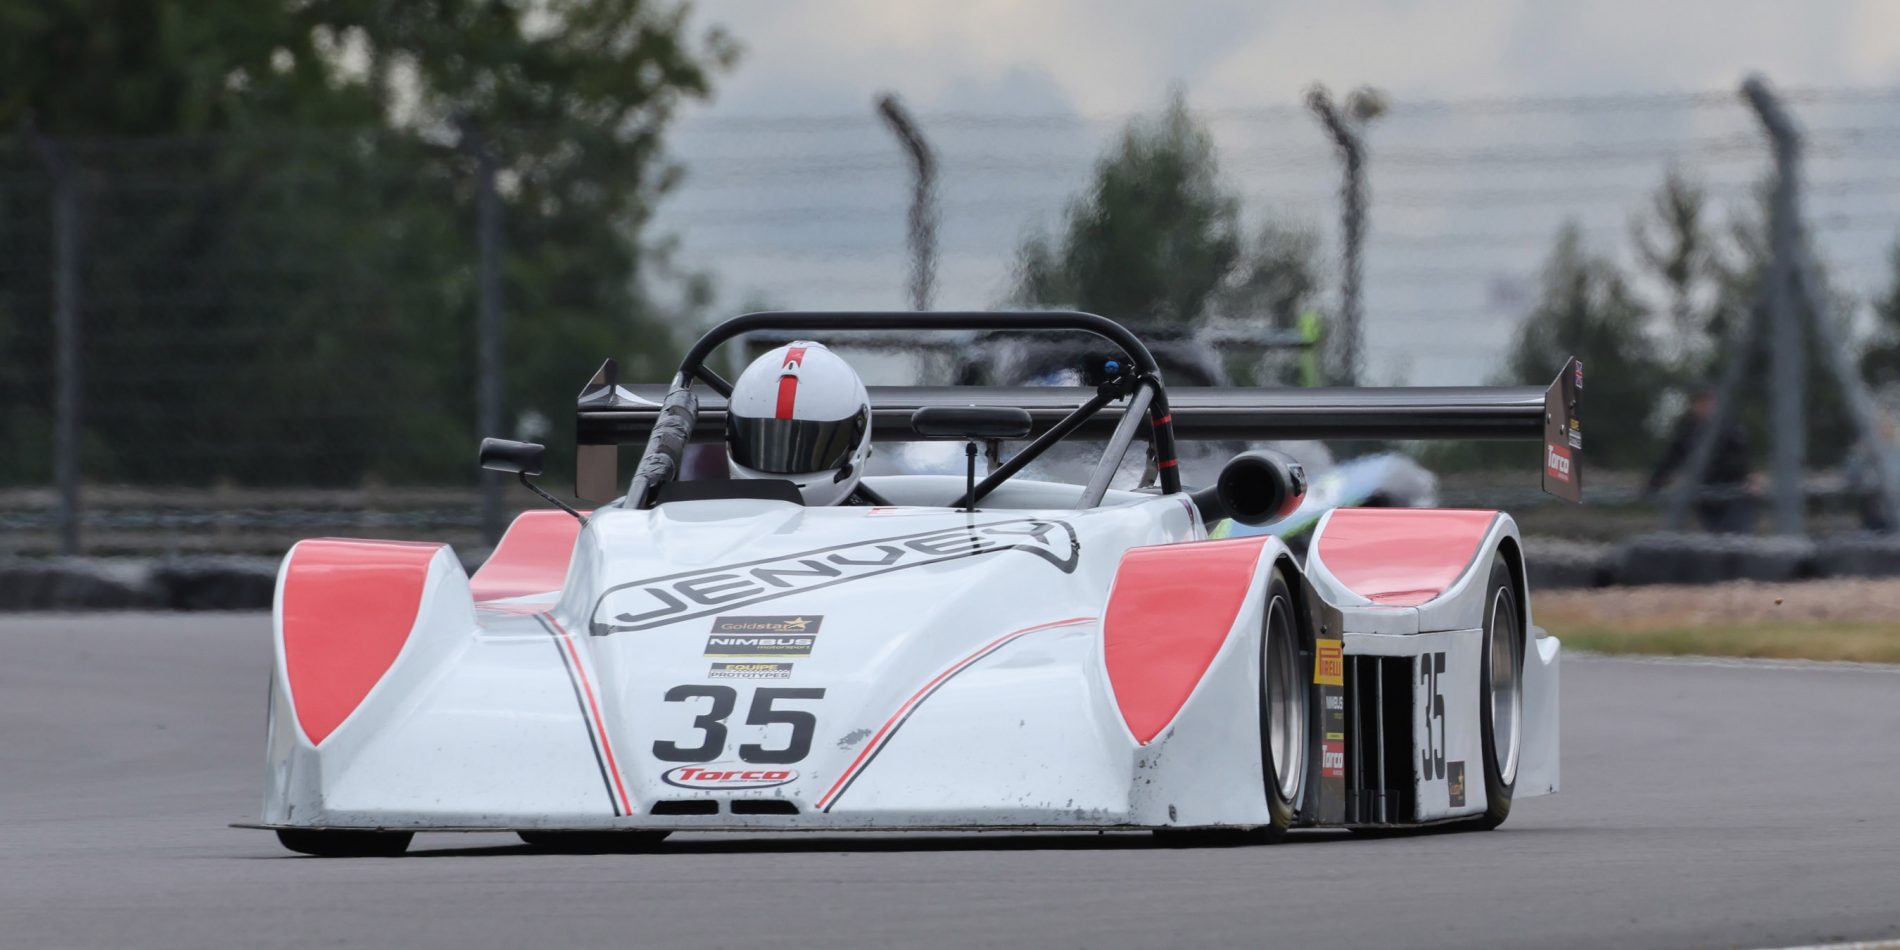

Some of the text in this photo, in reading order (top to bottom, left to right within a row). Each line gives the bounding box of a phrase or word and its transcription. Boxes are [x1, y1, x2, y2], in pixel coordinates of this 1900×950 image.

[1548, 445, 1569, 473] Torco
[615, 520, 1051, 622] JENVEY
[721, 622, 789, 632] Goldstar
[710, 638, 812, 646] NIMBUS
[1319, 648, 1342, 676] PIRELLI
[652, 684, 827, 765] 35
[1421, 652, 1446, 781] 35
[1322, 744, 1344, 769] Torco
[678, 768, 791, 781] Torco
